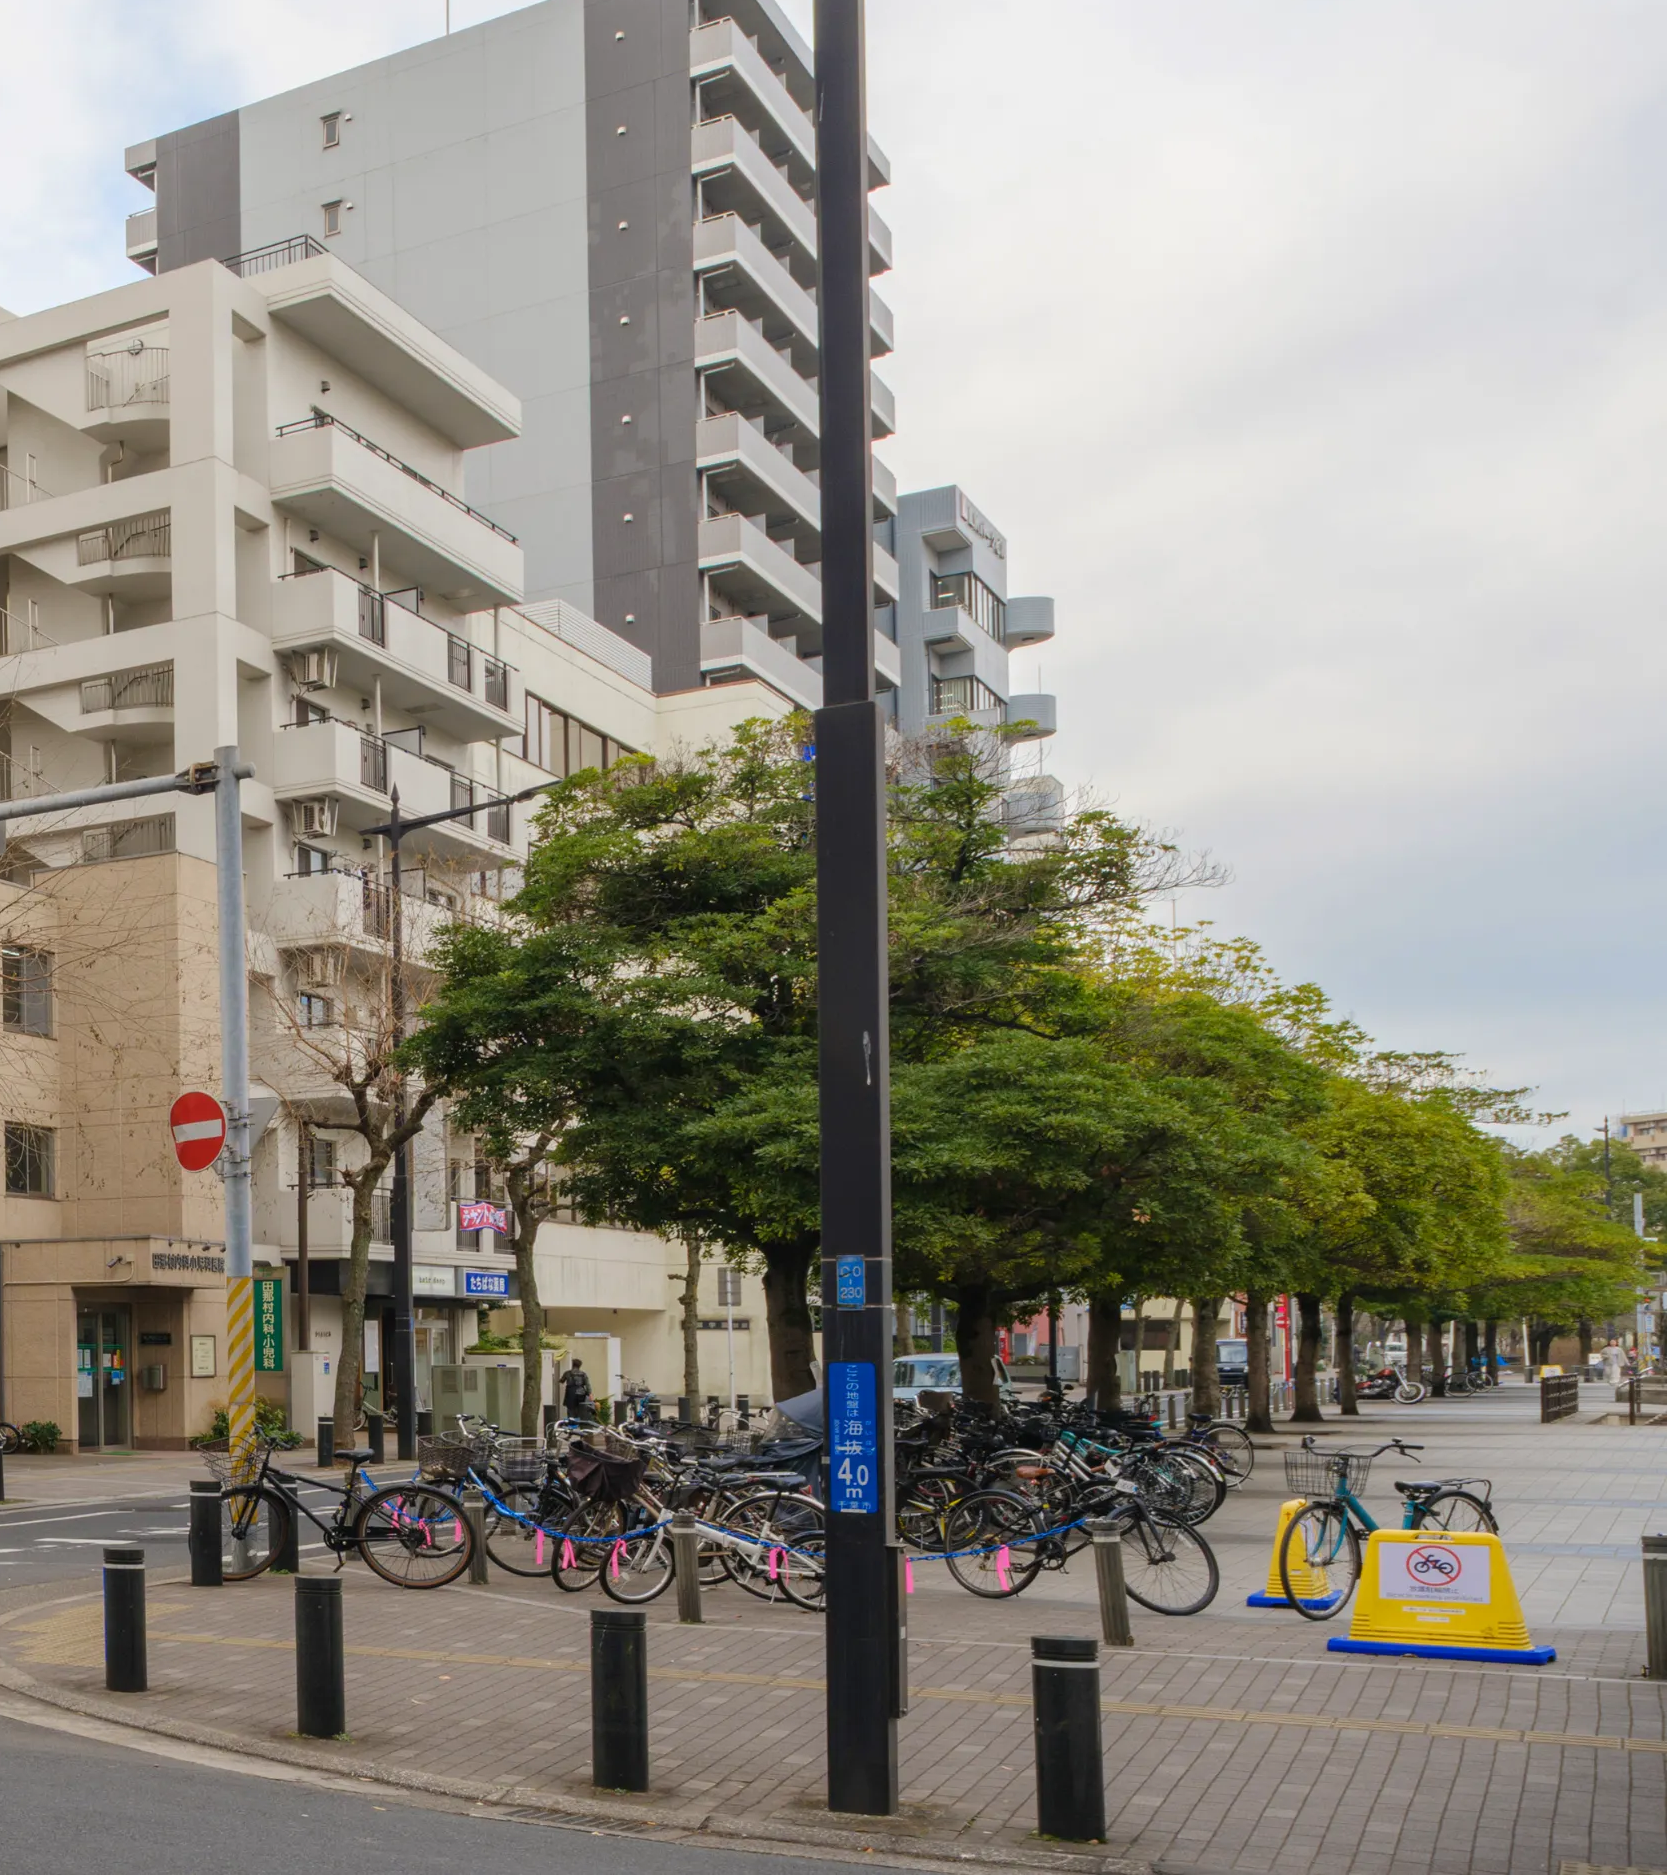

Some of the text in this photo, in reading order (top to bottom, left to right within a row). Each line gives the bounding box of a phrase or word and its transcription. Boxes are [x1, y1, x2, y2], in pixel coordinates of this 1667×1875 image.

[470, 1276, 506, 1293] たちばな薬局
[840, 1287, 863, 1299] 230
[846, 1365, 859, 1418] ここの地盤は
[843, 1419, 863, 1455] 海抜
[837, 1457, 869, 1486] 4.0
[846, 1487, 863, 1498] m
